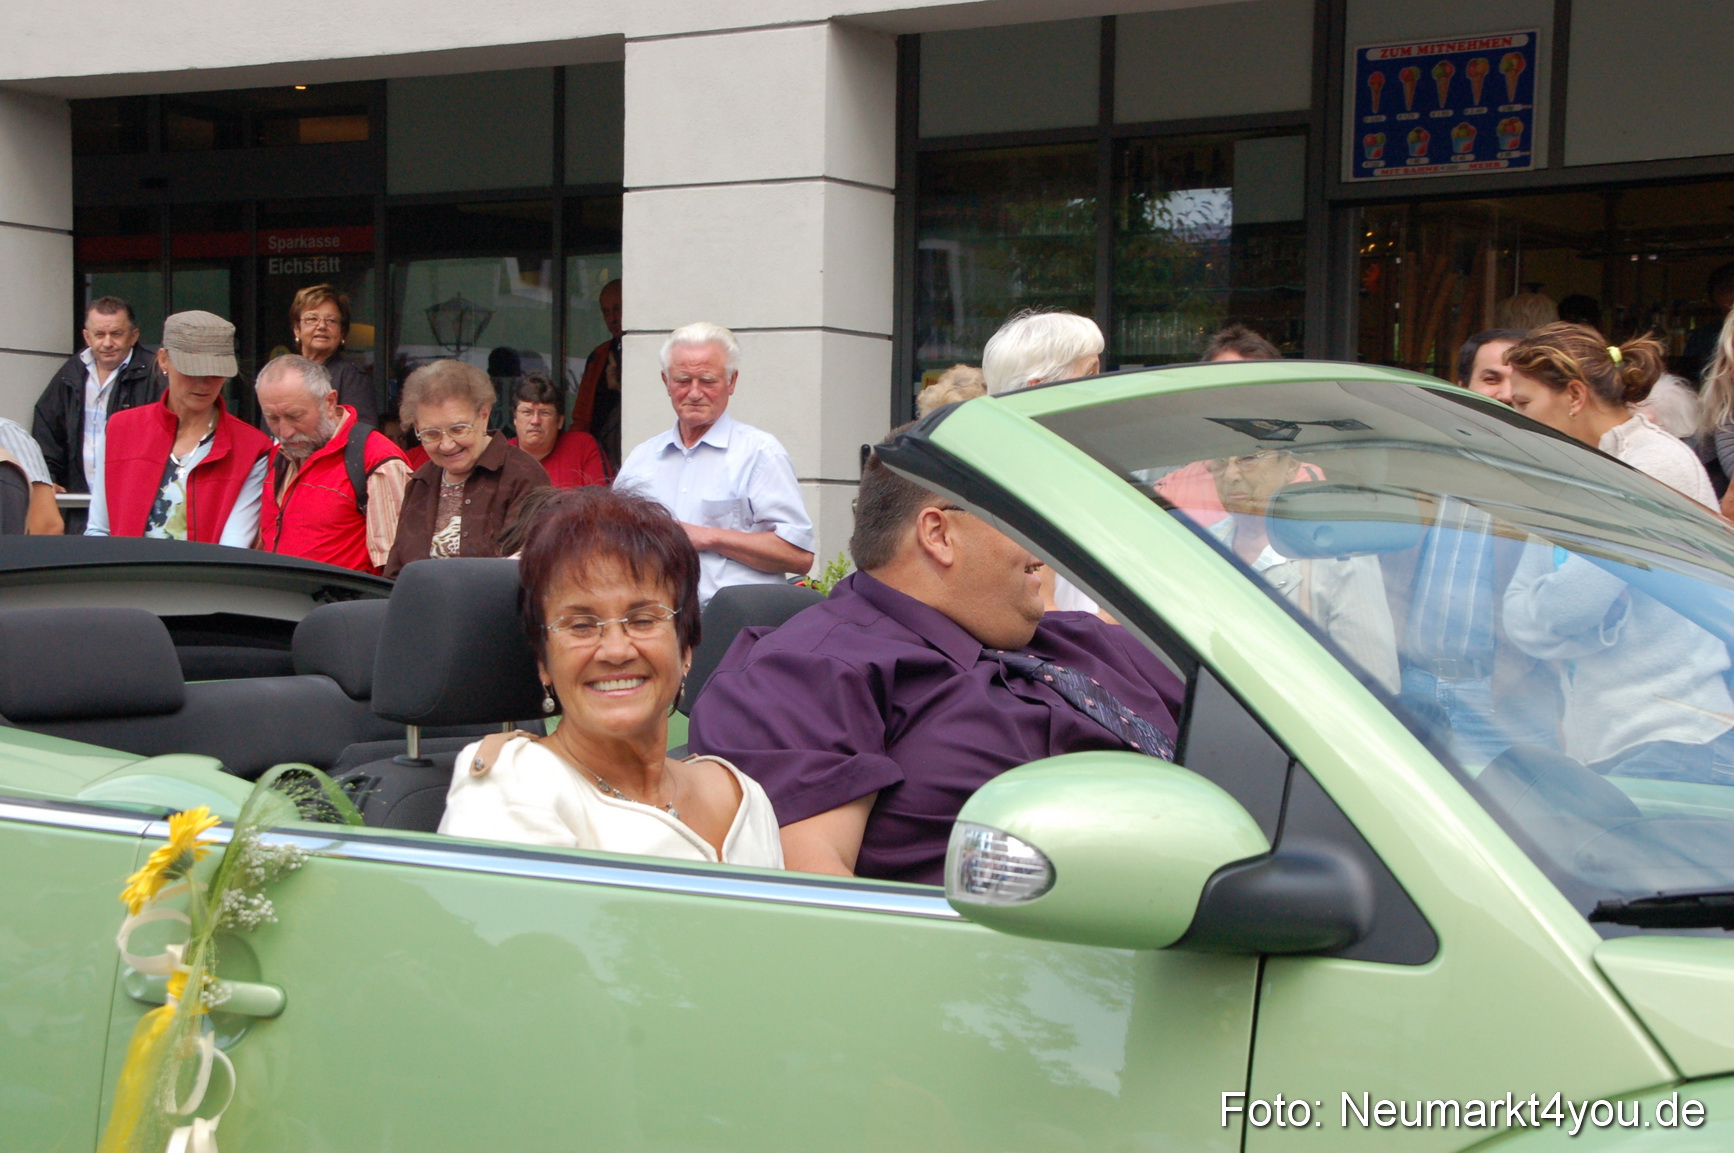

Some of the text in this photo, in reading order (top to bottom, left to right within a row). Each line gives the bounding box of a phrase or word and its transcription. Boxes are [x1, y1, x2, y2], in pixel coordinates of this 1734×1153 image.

[1380, 36, 1513, 59] ZUM MITNEHMEN
[268, 234, 341, 253] Sparkasse
[268, 255, 341, 275] Eichstätt
